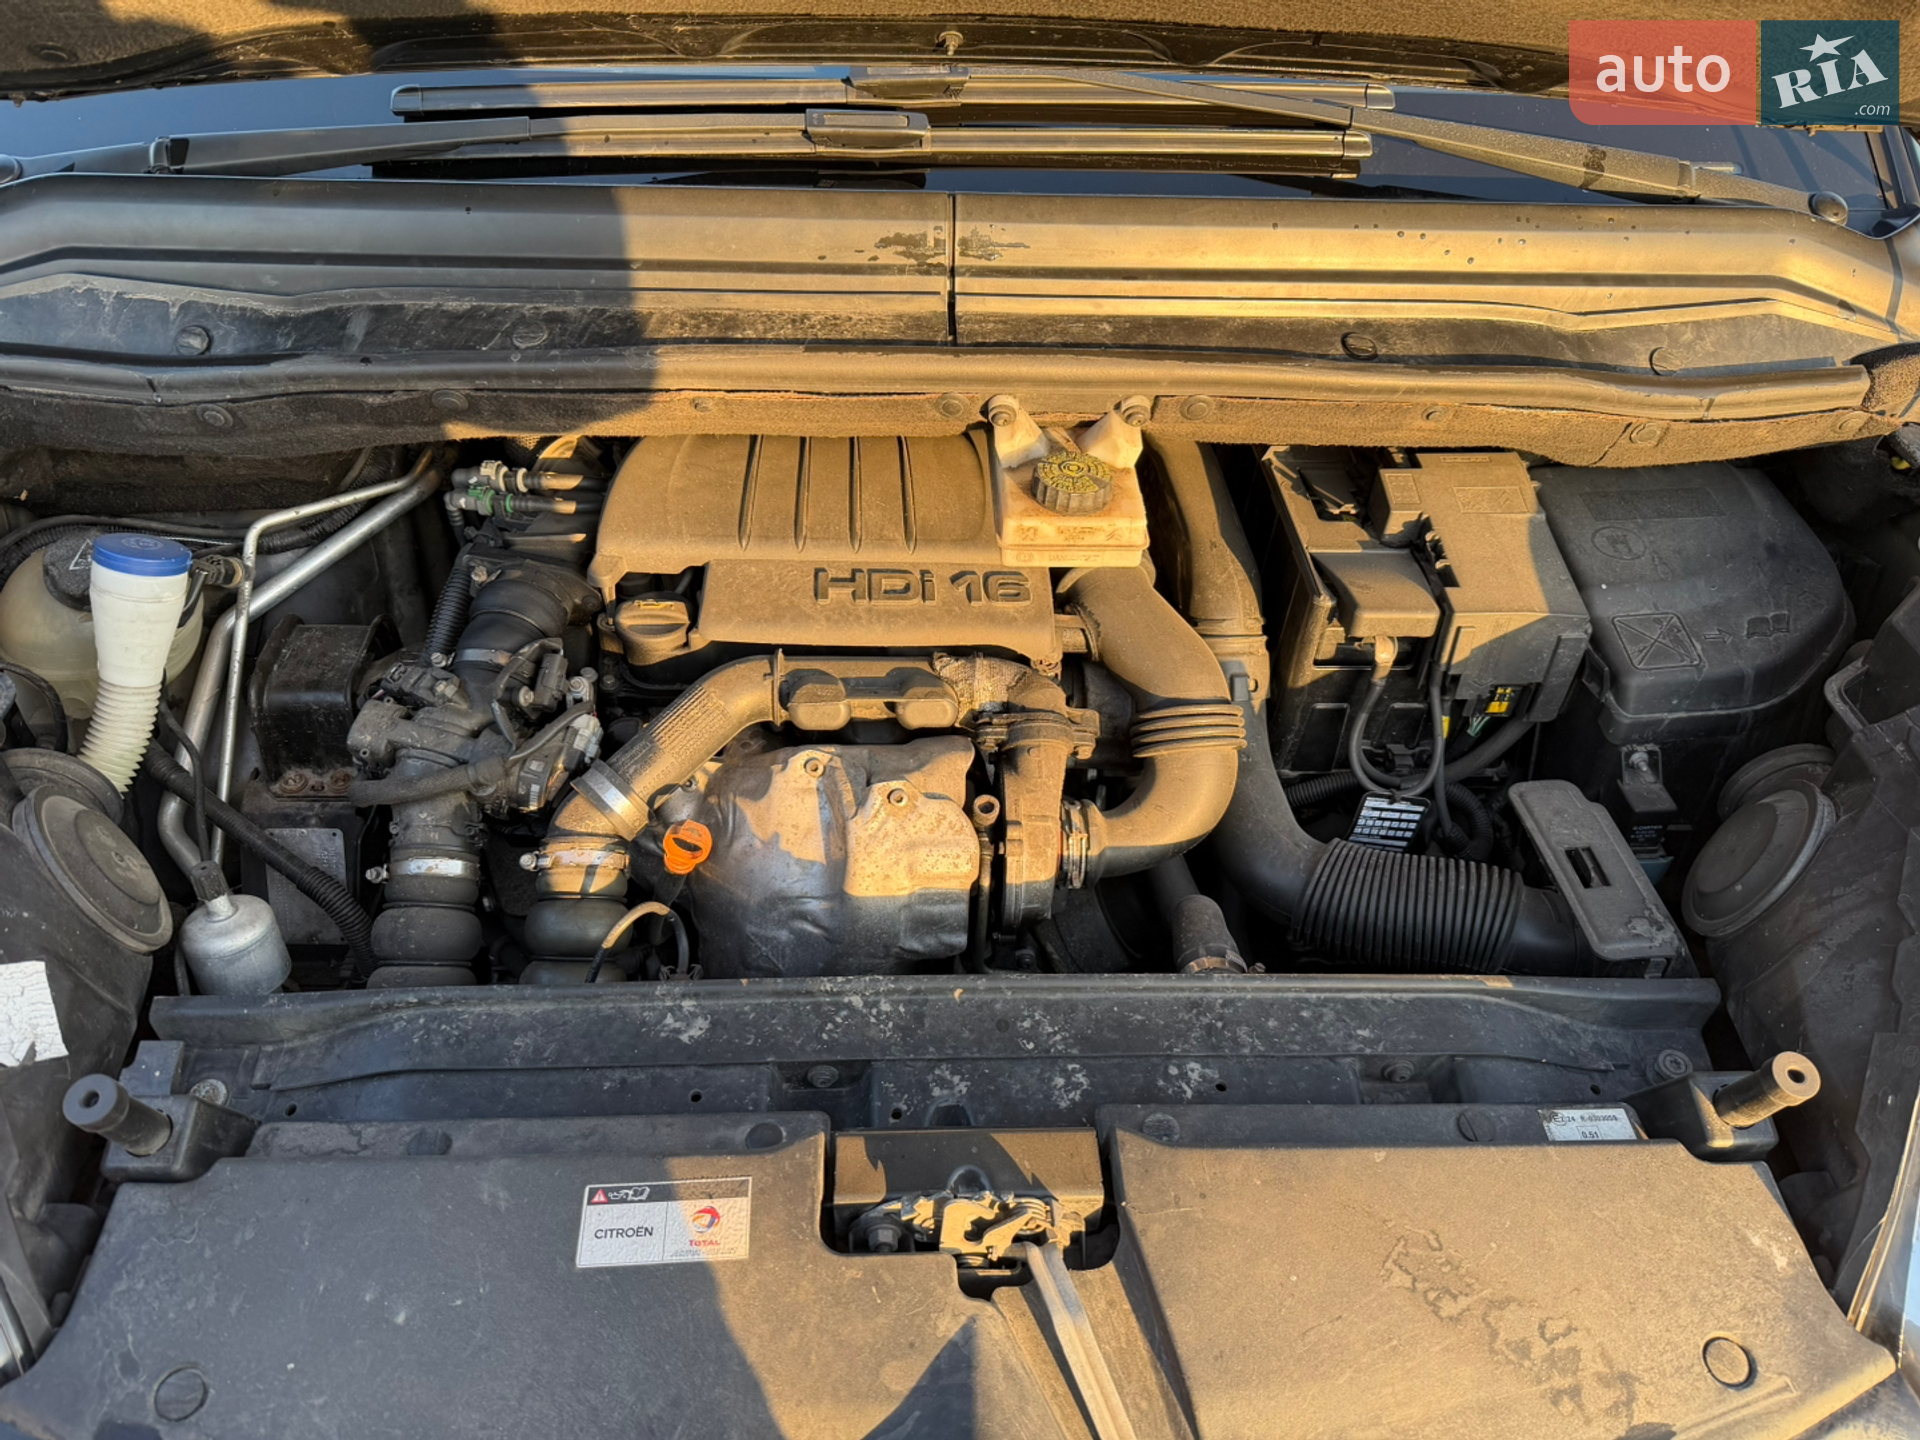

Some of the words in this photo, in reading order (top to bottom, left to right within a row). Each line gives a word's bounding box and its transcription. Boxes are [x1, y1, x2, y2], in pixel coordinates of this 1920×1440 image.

[814, 567, 937, 604] HDi
[950, 570, 1034, 606] 16
[1581, 1130, 1600, 1139] 0.51
[594, 1226, 654, 1240] CITROËN
[688, 1239, 721, 1247] TOTAL
